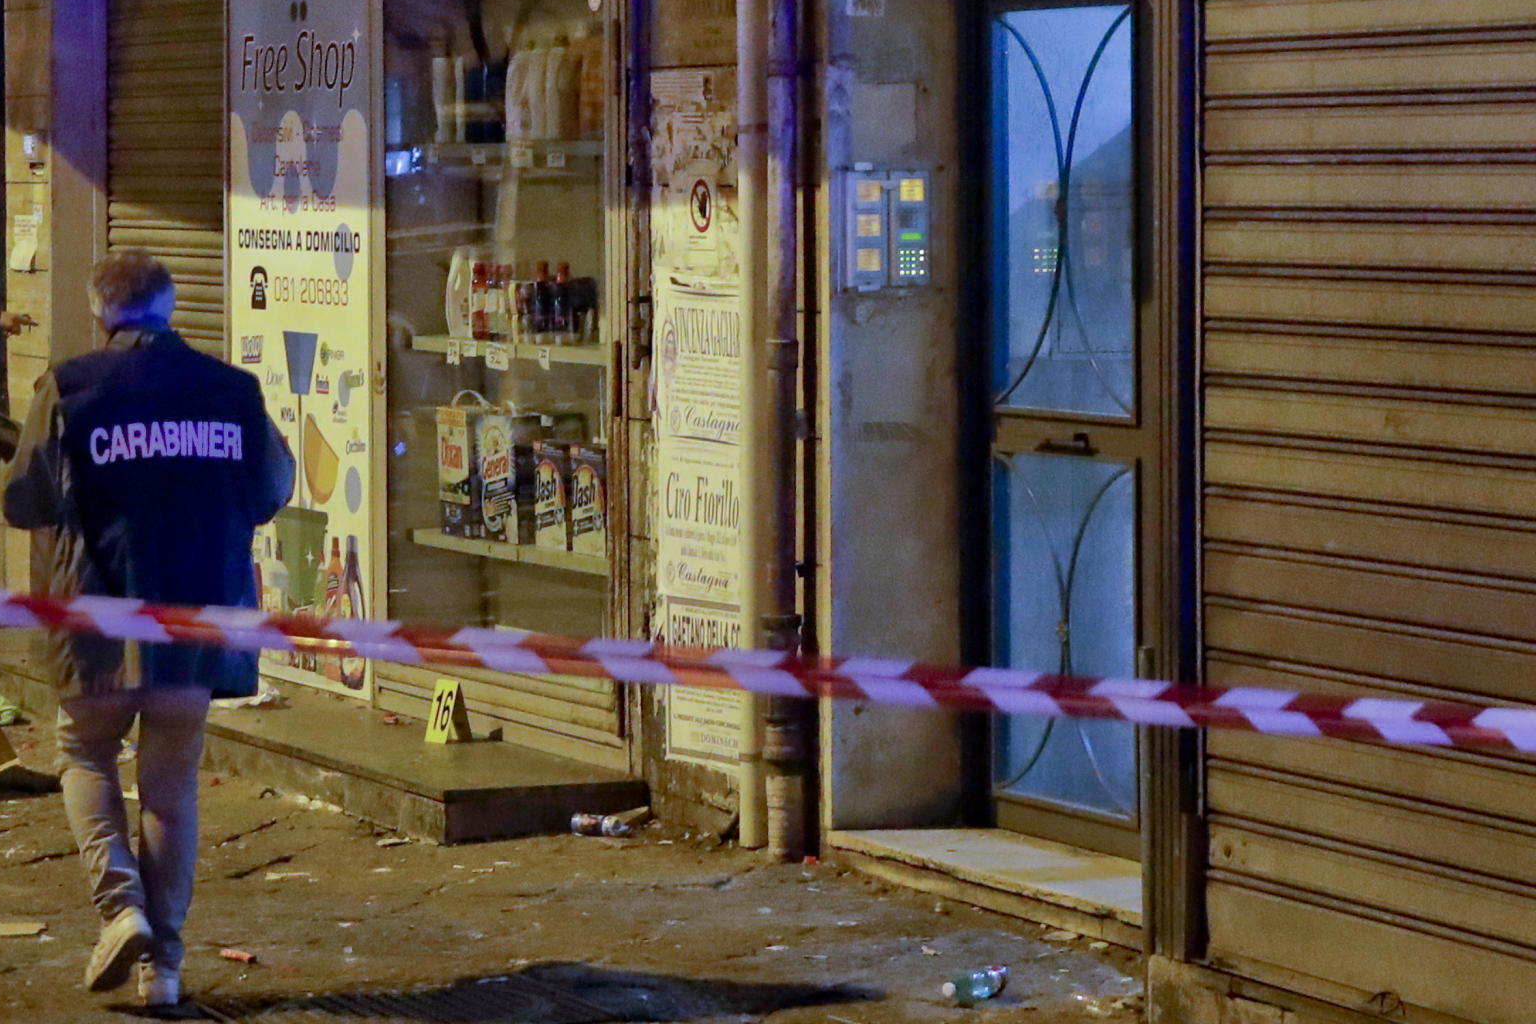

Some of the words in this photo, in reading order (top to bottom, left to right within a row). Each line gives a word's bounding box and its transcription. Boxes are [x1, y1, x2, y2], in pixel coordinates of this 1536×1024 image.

[241, 34, 289, 92] Free
[294, 29, 356, 109] Shop
[238, 227, 293, 252] CONSEGNA
[295, 230, 303, 253] A
[305, 230, 362, 255] DOMICILIO
[89, 419, 243, 466] CARABINIERI
[536, 467, 557, 504] Dash
[572, 472, 596, 509] Dash
[666, 471, 692, 521] Ciro
[677, 560, 730, 593] Castagna
[433, 688, 454, 732] 16
